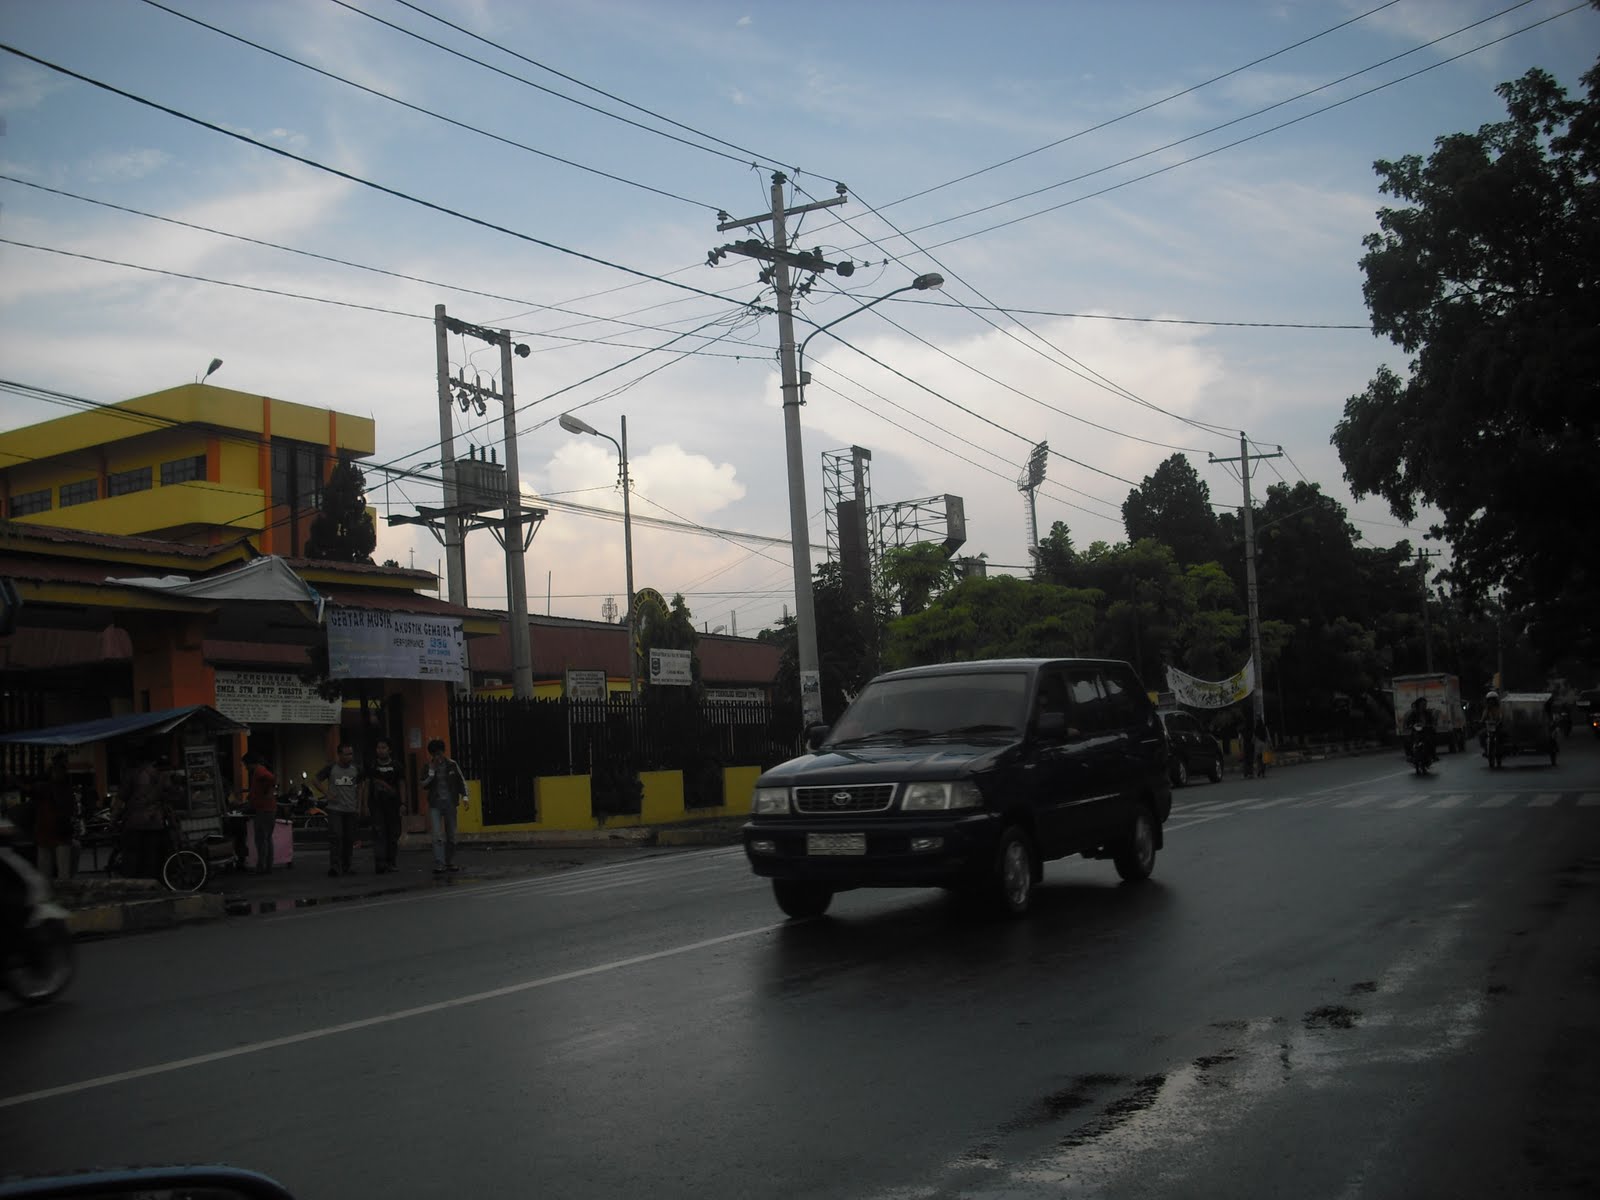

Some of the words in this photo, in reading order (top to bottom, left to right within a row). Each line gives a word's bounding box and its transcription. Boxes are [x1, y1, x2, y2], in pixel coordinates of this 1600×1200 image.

[331, 611, 365, 627] GEBYAR
[367, 612, 393, 628] MUSIK
[394, 622, 423, 635] AKUSTIK
[424, 624, 452, 638] GEMBIRA
[393, 638, 425, 648] PERFORMANCE
[237, 673, 293, 682] PERGURUAN
[278, 687, 303, 696] SWASTA
